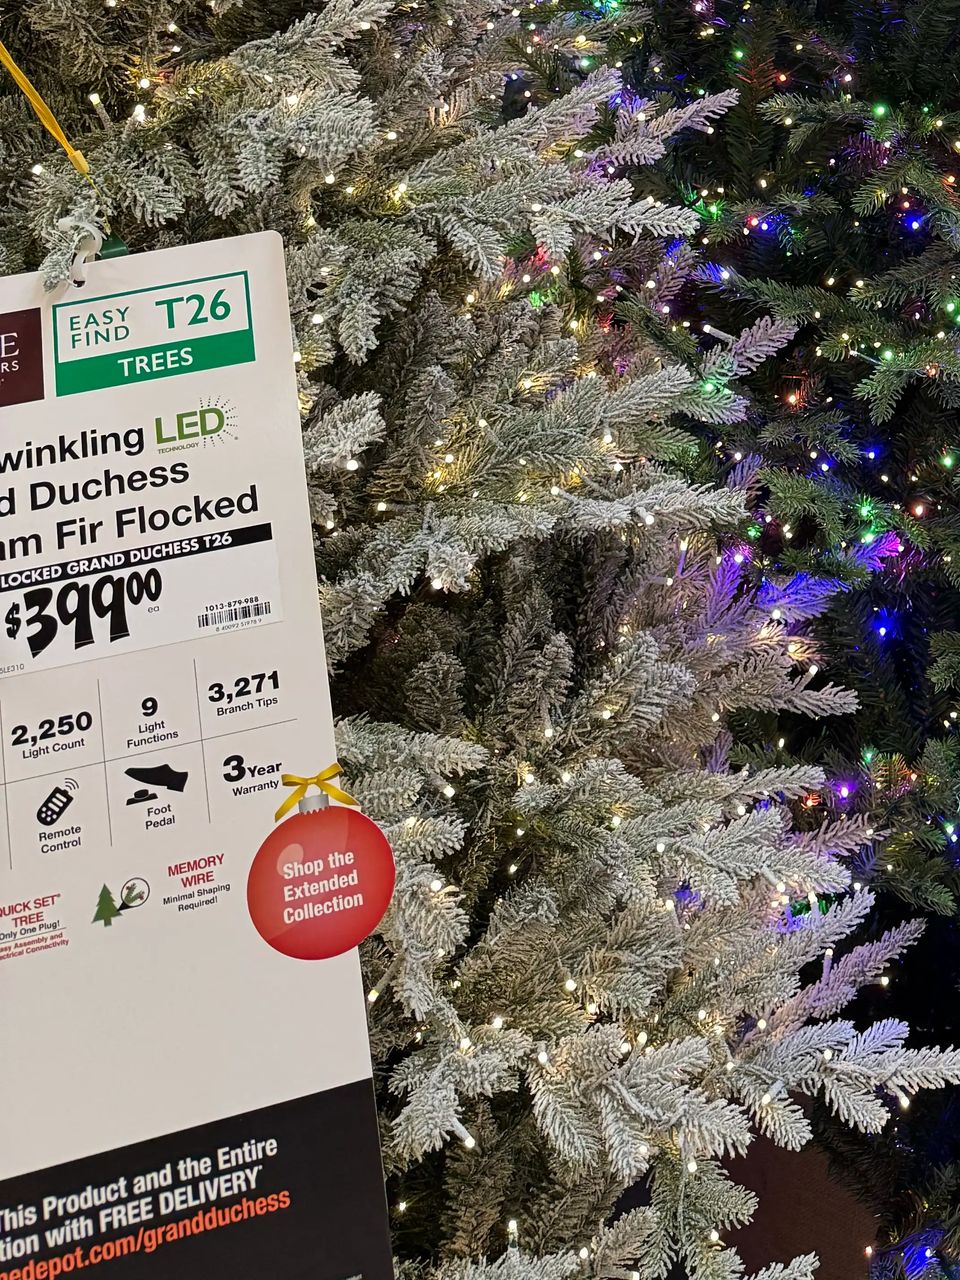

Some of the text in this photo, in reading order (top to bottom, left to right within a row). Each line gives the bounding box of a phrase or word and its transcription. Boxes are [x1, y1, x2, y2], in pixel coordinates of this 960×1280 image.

[69, 306, 130, 331] EASY
[155, 288, 231, 329] T26
[72, 325, 130, 349] FIND
[118, 348, 193, 377] TREES
[155, 407, 225, 444] LED
[158, 442, 200, 455] TECHNOLOGY
[30, 462, 189, 511] Duchess
[56, 484, 259, 550] Fir Flocked
[67, 552, 125, 576] GRAND
[130, 538, 200, 564] DUCHESS
[203, 532, 232, 549] T26
[148, 605, 160, 614] ea
[205, 596, 259, 612] 1013-879-988
[208, 670, 280, 704] 3,271
[141, 697, 158, 717] 9
[216, 696, 279, 716] Branch Tips
[11, 711, 93, 747] 2,250
[138, 720, 165, 734] Light
[22, 738, 85, 759] Light Count
[127, 730, 179, 749] Functions
[232, 780, 279, 797] Warranty
[147, 804, 172, 817] Foot
[145, 815, 176, 830] Pedal
[39, 825, 82, 842] Remote
[41, 837, 81, 854] Control
[168, 853, 224, 877] MEMORY
[283, 851, 355, 882] Shop the
[181, 870, 215, 888] WIRE
[284, 869, 359, 902] Extended
[163, 883, 231, 905] Minimal Shaping
[178, 895, 218, 912] Required!
[283, 893, 364, 924] Collection
[0, 920, 60, 940] Only One Plug!
[11, 912, 44, 928] TREE
[14, 932, 63, 949] Assembly and
[26, 939, 69, 954] Connectivity
[42, 1176, 128, 1220] Product
[133, 1163, 172, 1195] and
[177, 1156, 212, 1181] the
[217, 1138, 278, 1170] Entire
[45, 1216, 94, 1249] with
[99, 1198, 154, 1233] FREE
